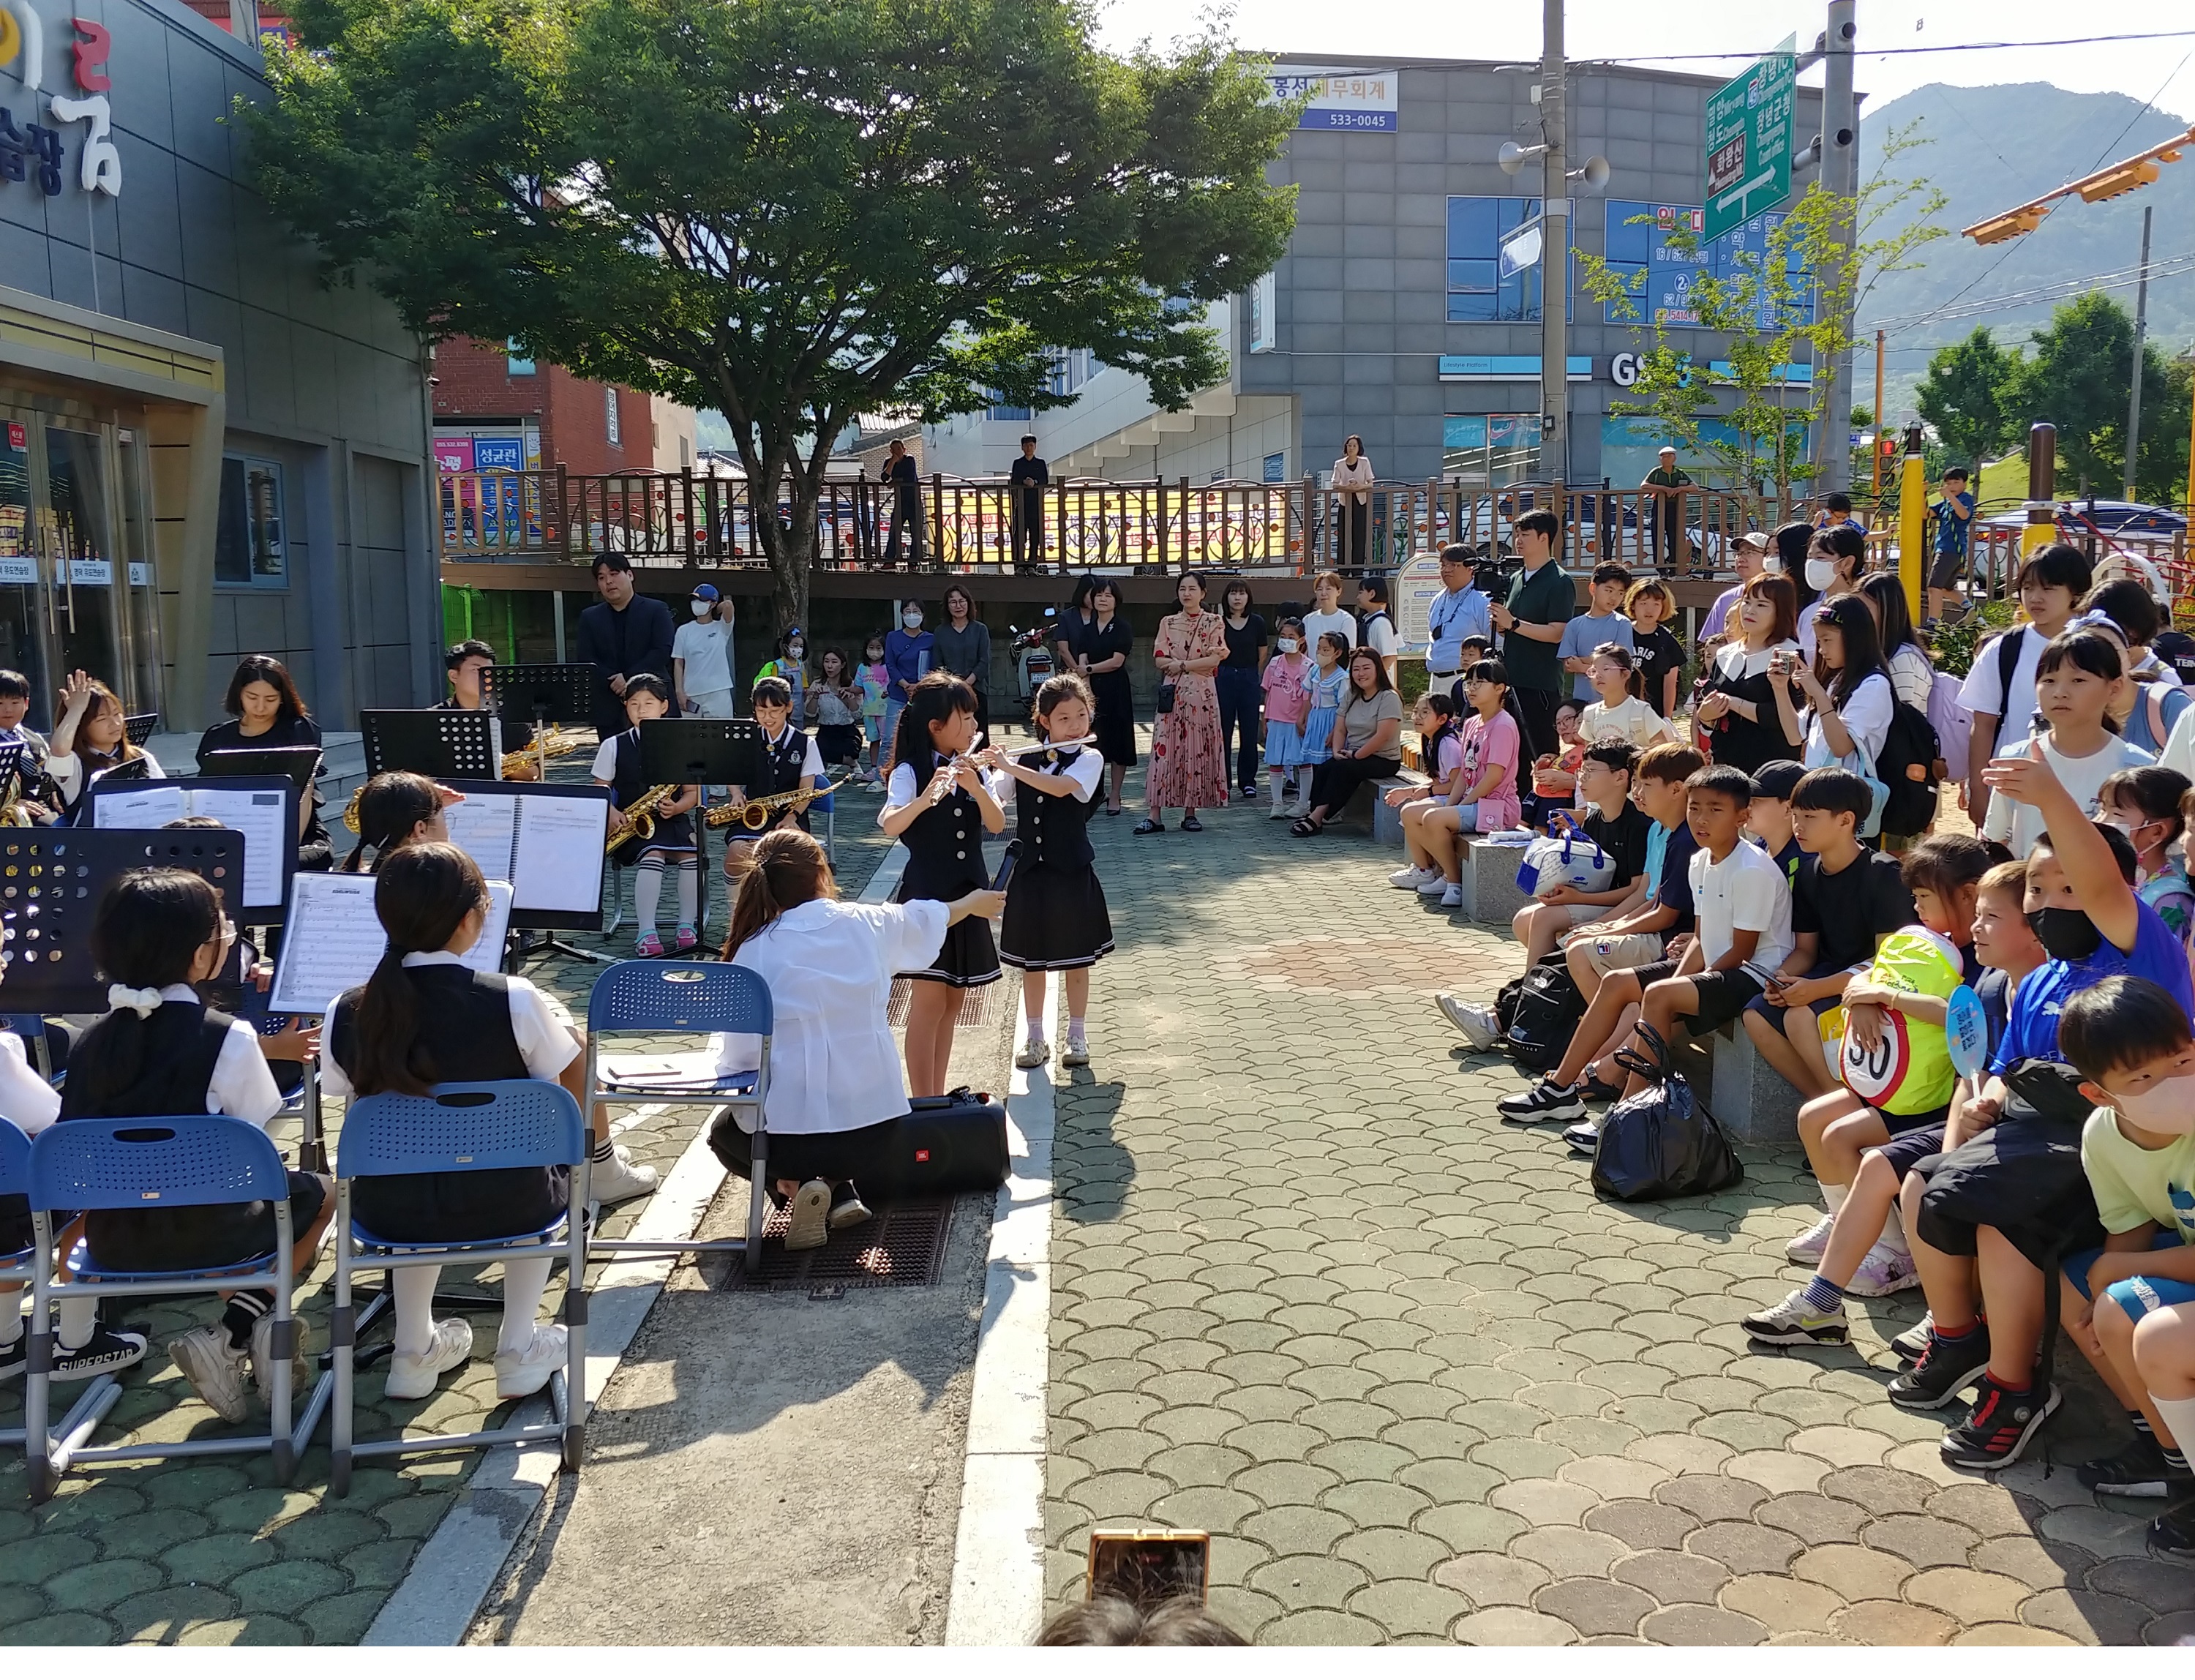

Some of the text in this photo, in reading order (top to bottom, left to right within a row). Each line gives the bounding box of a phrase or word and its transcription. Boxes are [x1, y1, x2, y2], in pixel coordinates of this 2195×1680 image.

[1757, 91, 1791, 134] 창녕군청
[1330, 114, 1386, 127] 533-0045
[1716, 138, 1743, 174] 화왕산
[480, 448, 517, 463] 성균관
[4, 566, 29, 576] 유도연습장
[1632, 646, 1656, 661] ARIS
